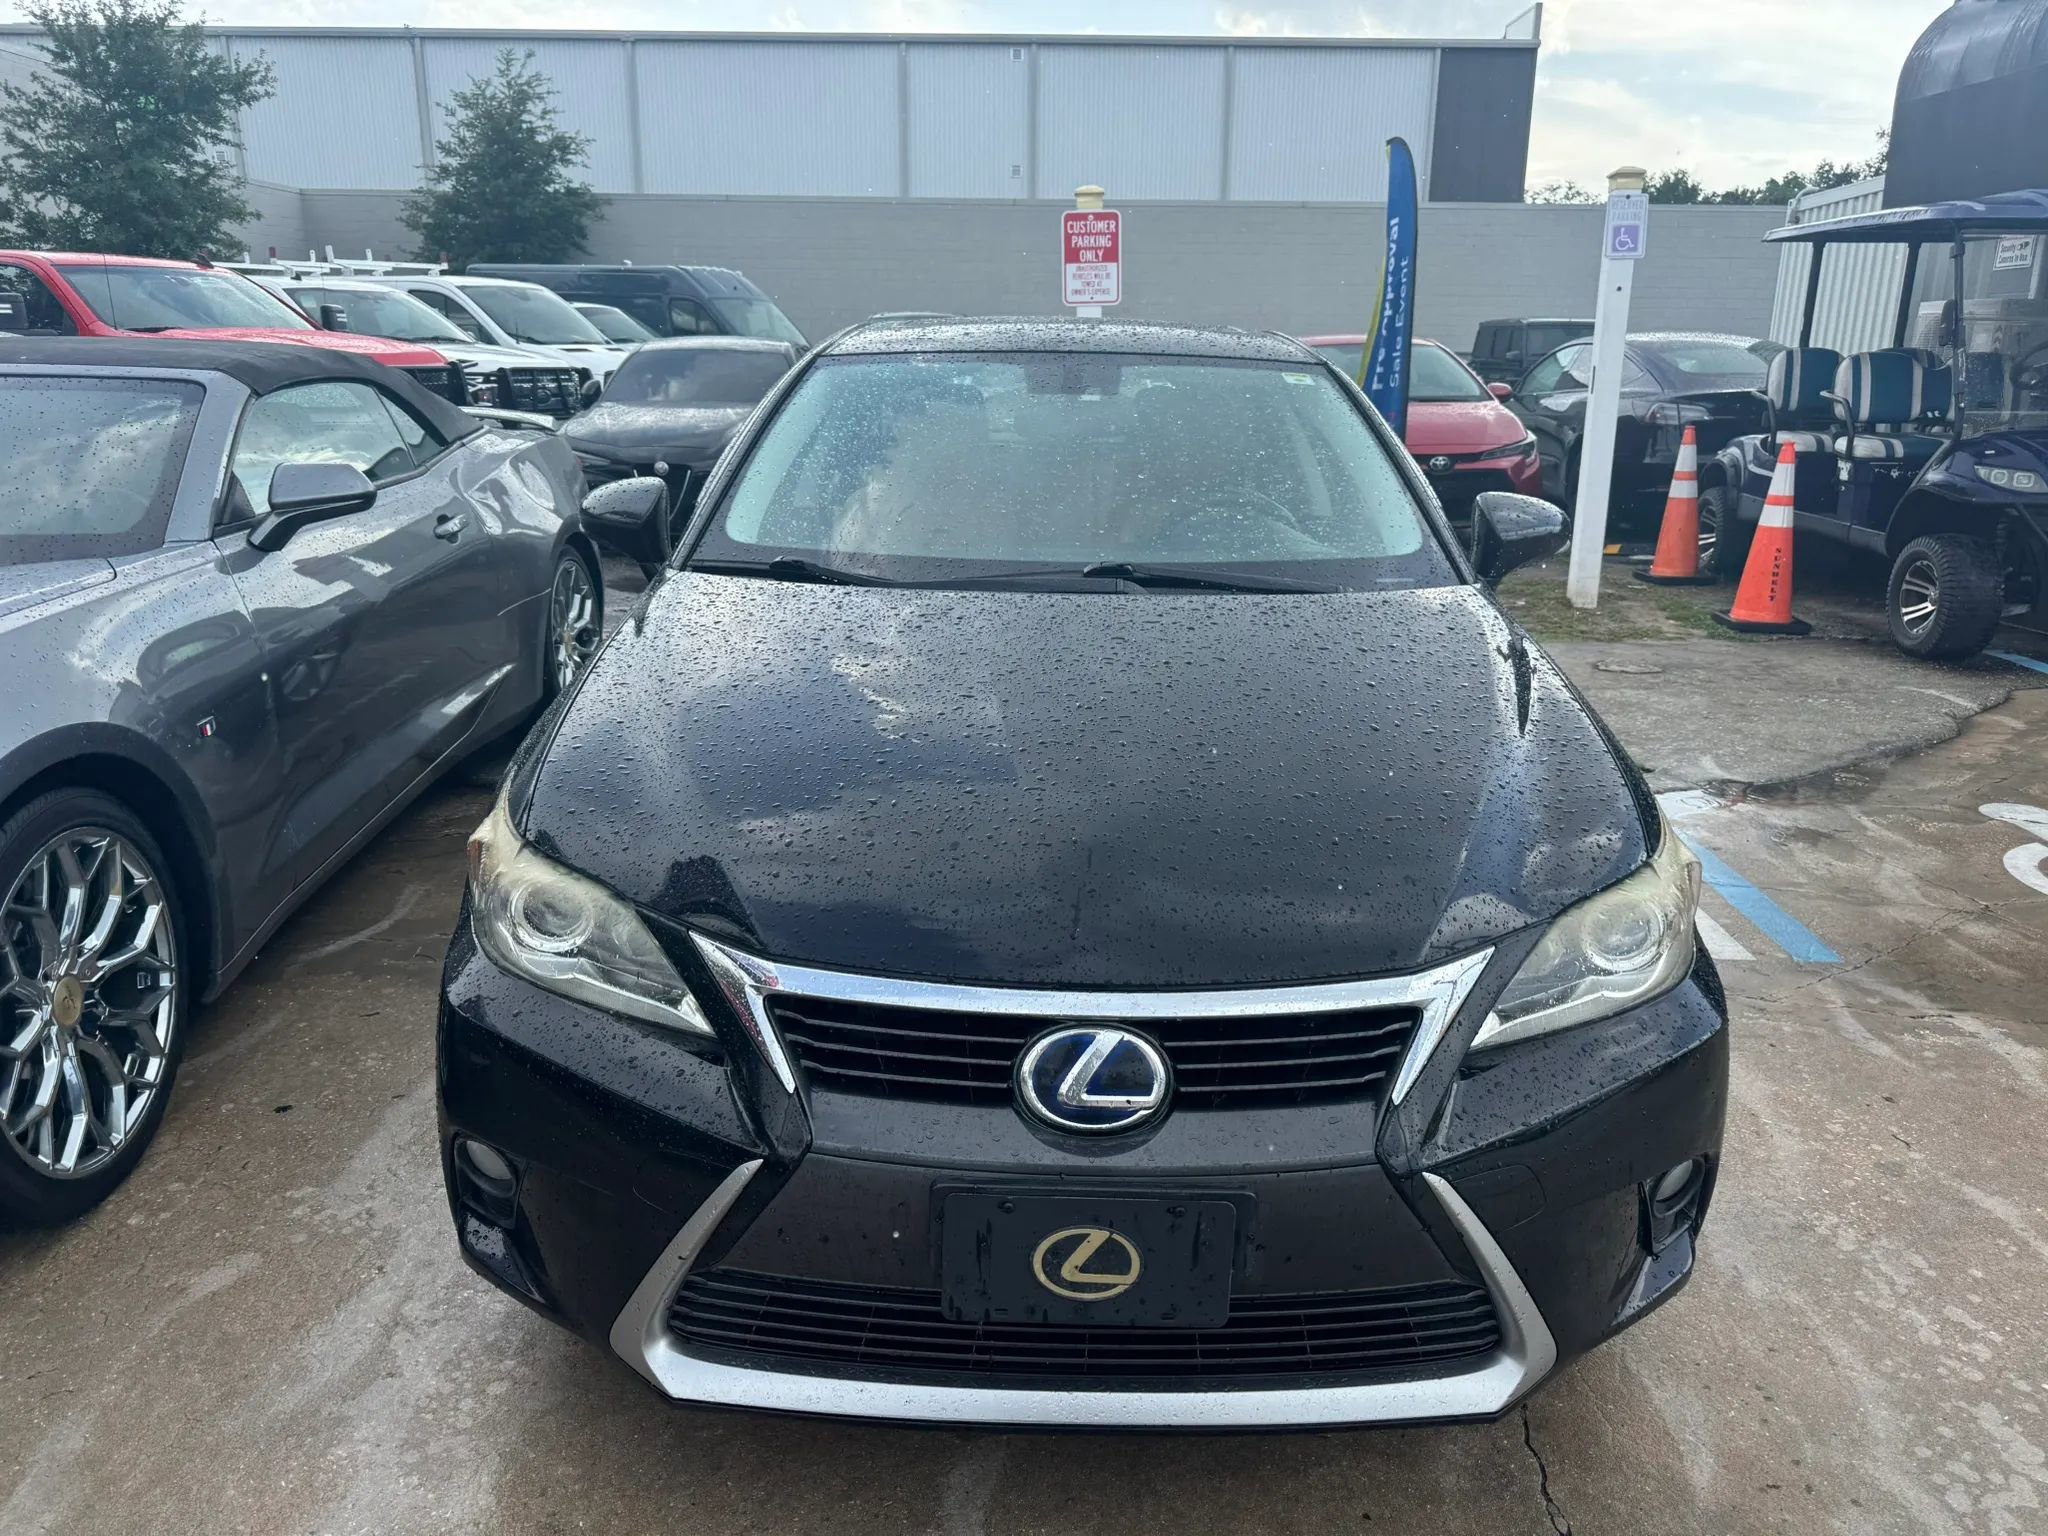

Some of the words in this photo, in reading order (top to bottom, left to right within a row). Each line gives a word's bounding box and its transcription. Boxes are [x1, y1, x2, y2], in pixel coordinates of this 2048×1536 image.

[1067, 220, 1116, 234] CUSTOMER
[1071, 235, 1112, 248] PARKING
[1079, 249, 1104, 262] ONLY
[1395, 256, 1409, 328] Event
[1390, 336, 1402, 387] Sale
[1767, 547, 1782, 602] SUNBELT
